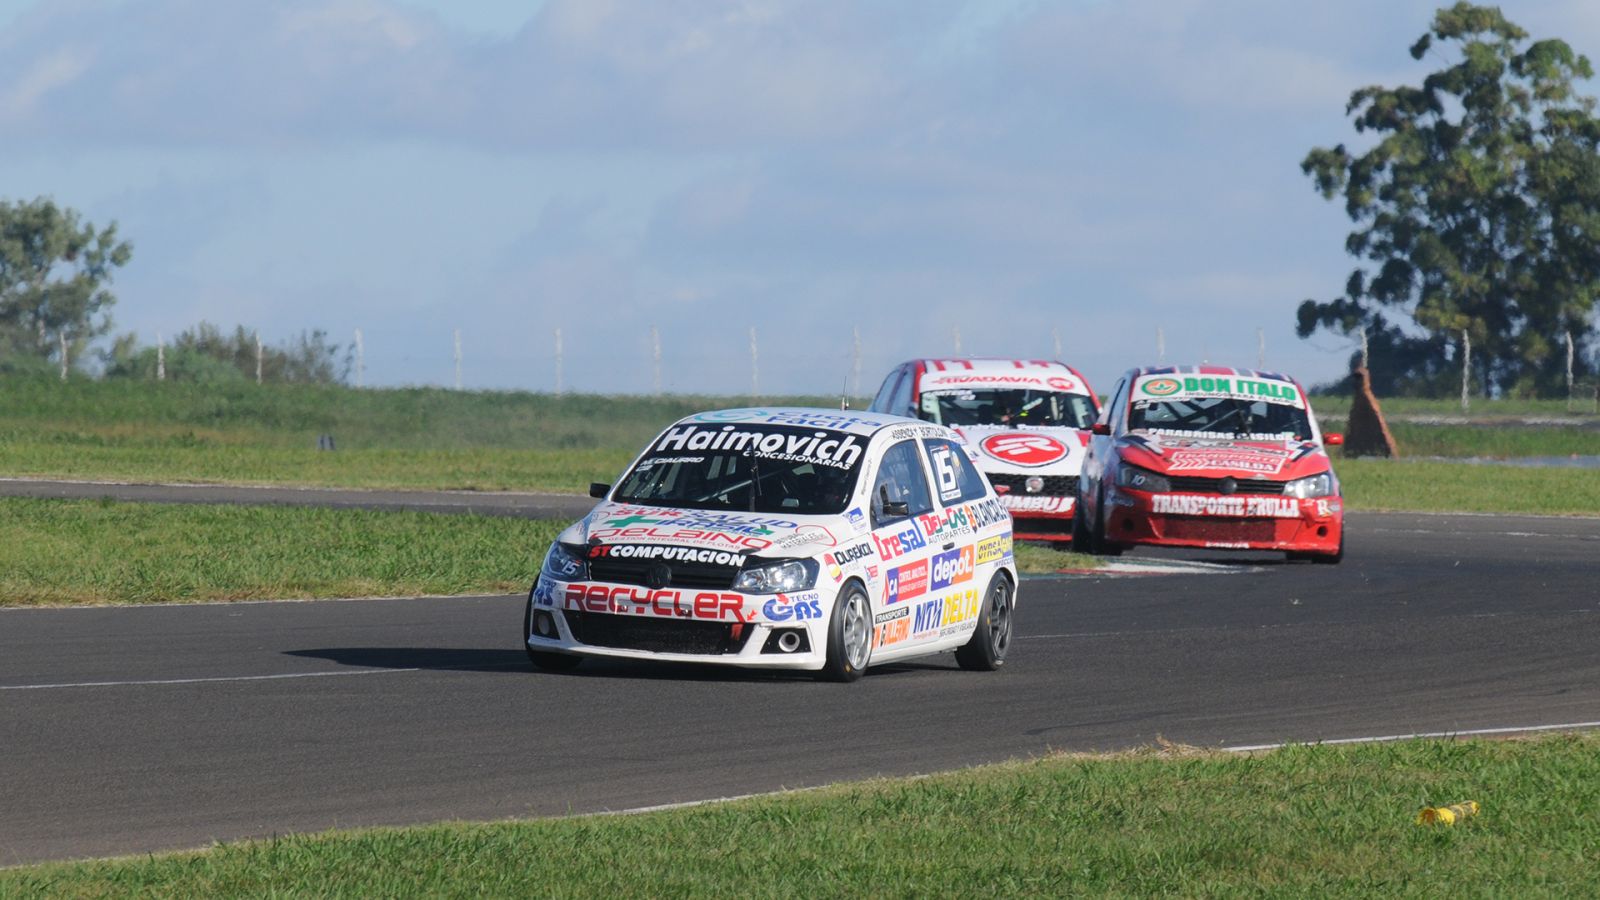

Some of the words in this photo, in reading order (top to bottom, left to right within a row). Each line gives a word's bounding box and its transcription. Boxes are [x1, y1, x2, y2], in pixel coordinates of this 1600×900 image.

[1184, 377, 1230, 393] DON
[1237, 379, 1296, 401] ITALO
[778, 411, 882, 427] Cuota
[1148, 428, 1235, 440] PARABRISAS
[656, 425, 862, 464] Haimovich
[743, 450, 853, 471] CONCESIONARIAS
[1177, 452, 1282, 464] TRANSPORTE
[1210, 459, 1275, 471] CASILDA
[933, 450, 957, 492] 15
[1152, 494, 1246, 516] TRANSPORTE
[1247, 496, 1300, 517] FRULLA
[690, 510, 798, 529] SALUD
[871, 517, 927, 561] tresal
[928, 526, 971, 544] AUTOPARTES
[561, 560, 580, 575] 15
[791, 593, 820, 603] TECNO
[876, 607, 908, 624] TRANSPORTE
[941, 587, 979, 628] DELTA
